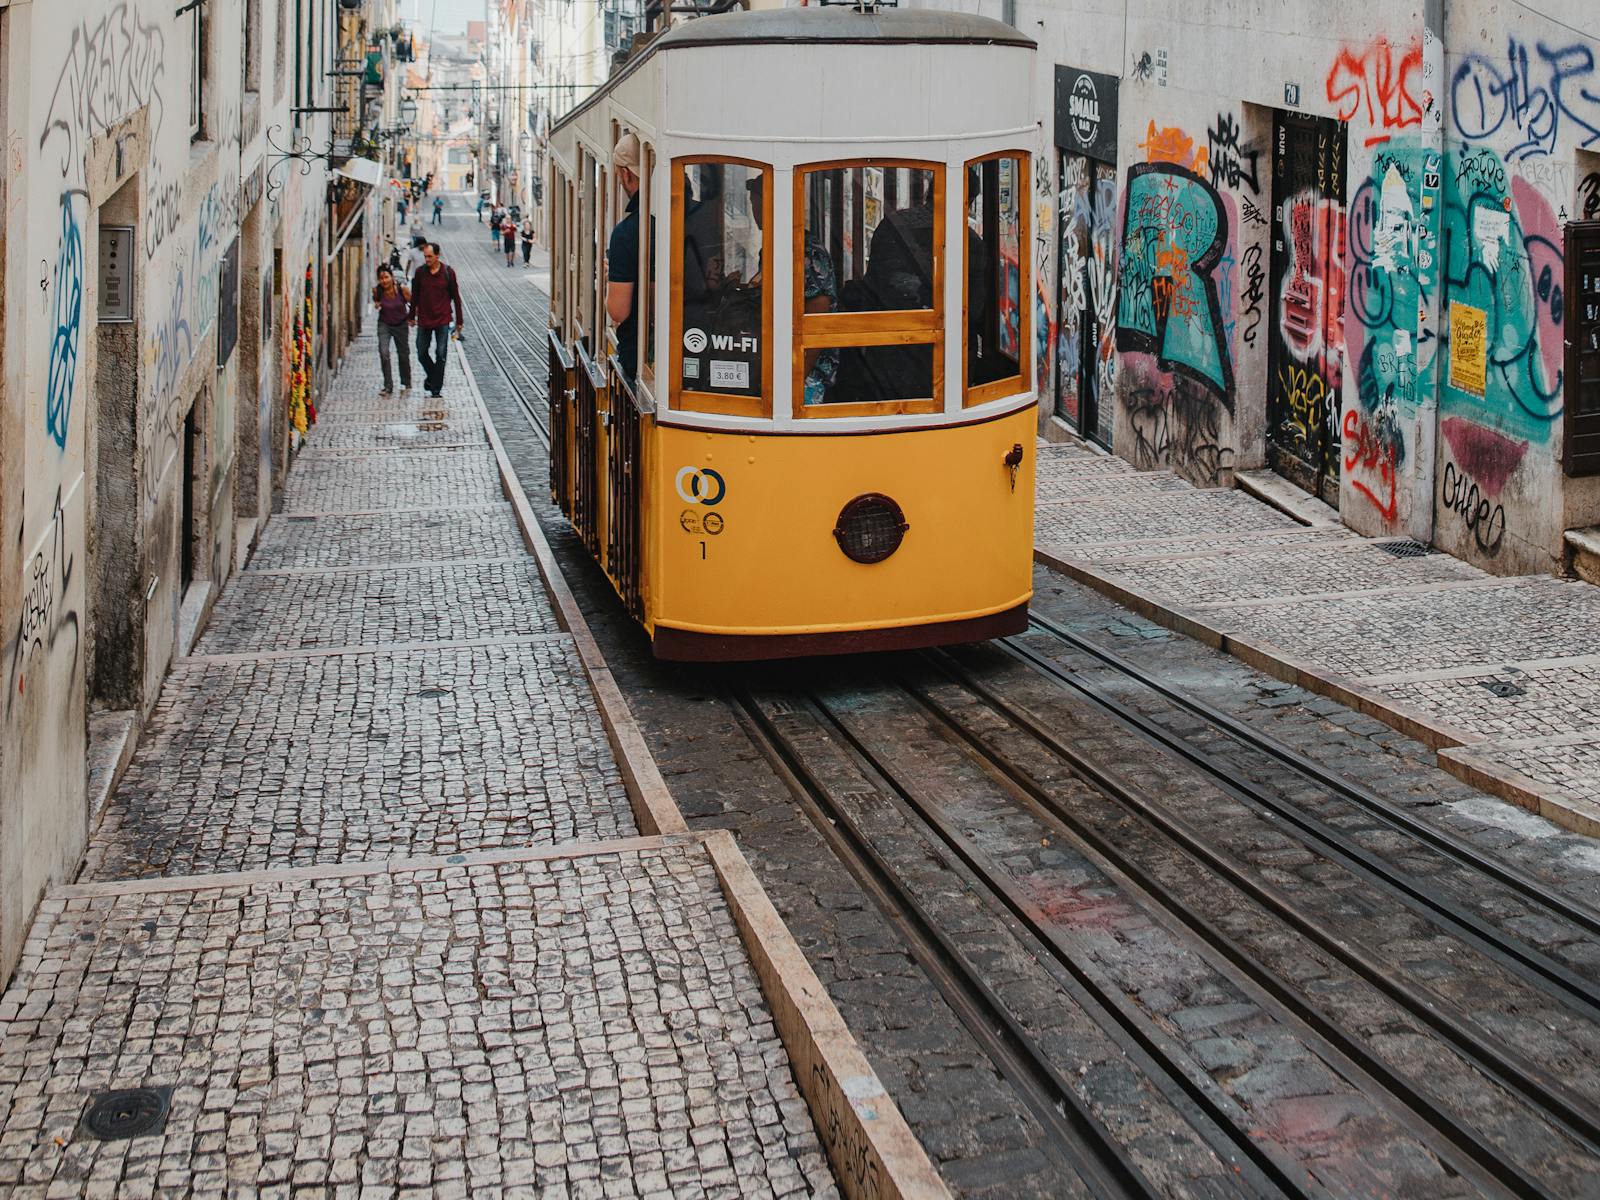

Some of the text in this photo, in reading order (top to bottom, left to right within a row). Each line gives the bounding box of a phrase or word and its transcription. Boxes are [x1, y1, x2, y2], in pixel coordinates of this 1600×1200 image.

[1069, 95, 1101, 123] SMALL
[1078, 119, 1091, 132] BAR
[1278, 125, 1286, 156] ADUR
[711, 334, 758, 353] WI-FI
[716, 372, 743, 381] 3.80 €
[699, 541, 706, 560] 1
